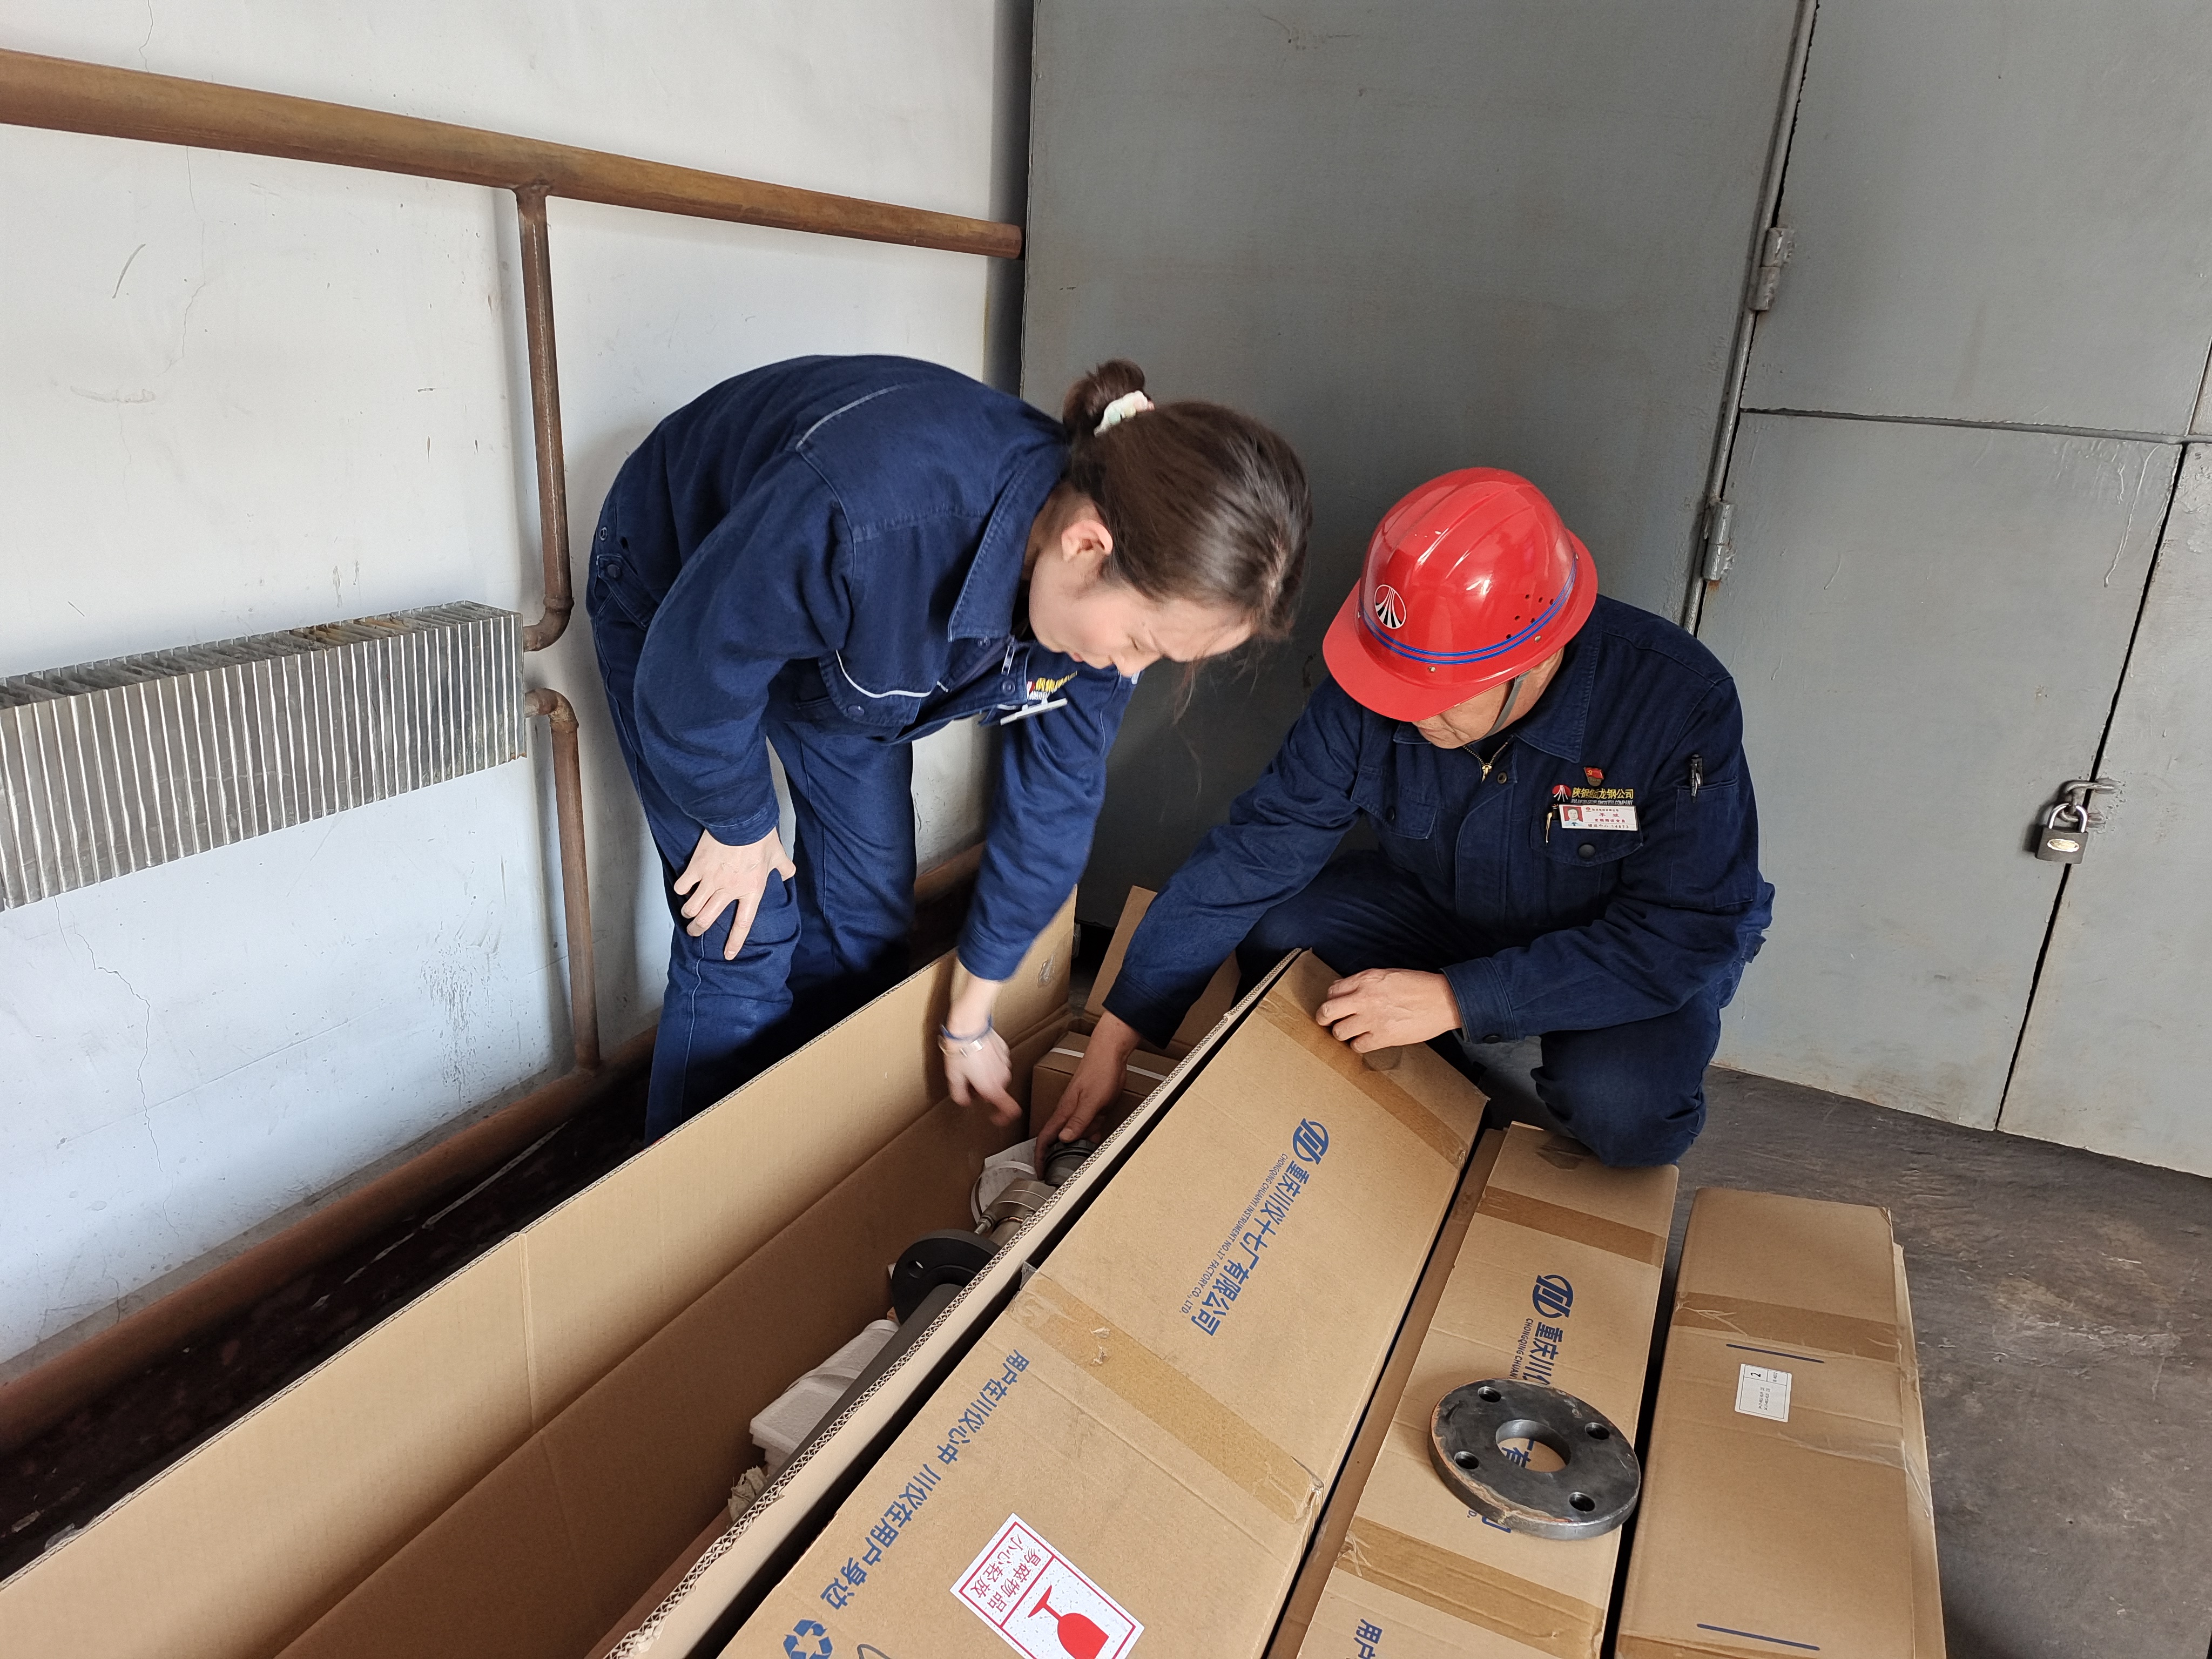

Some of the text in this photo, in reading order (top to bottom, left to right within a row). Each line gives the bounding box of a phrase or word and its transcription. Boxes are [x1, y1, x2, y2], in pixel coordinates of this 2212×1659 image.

[1266, 1153, 1288, 1184] CHONGQING
[1250, 1183, 1269, 1207] CHUANYI
[1228, 1204, 1256, 1243] INSTRUMENT
[1191, 1161, 1310, 1336] 重庆川仪十七厂有限公司
[1216, 1240, 1232, 1260] NO.17
[1197, 1259, 1219, 1289] FACTORY
[1179, 1298, 1193, 1314] LTD.
[1518, 1318, 1533, 1355] CHONGQING
[1508, 1355, 1522, 1379] CHUAN
[820, 1349, 1030, 1610] 用户在川仪心中 川仪在用户身边
[970, 1534, 1024, 1598] 小心轻放
[987, 1548, 1041, 1612] 易碎物品
